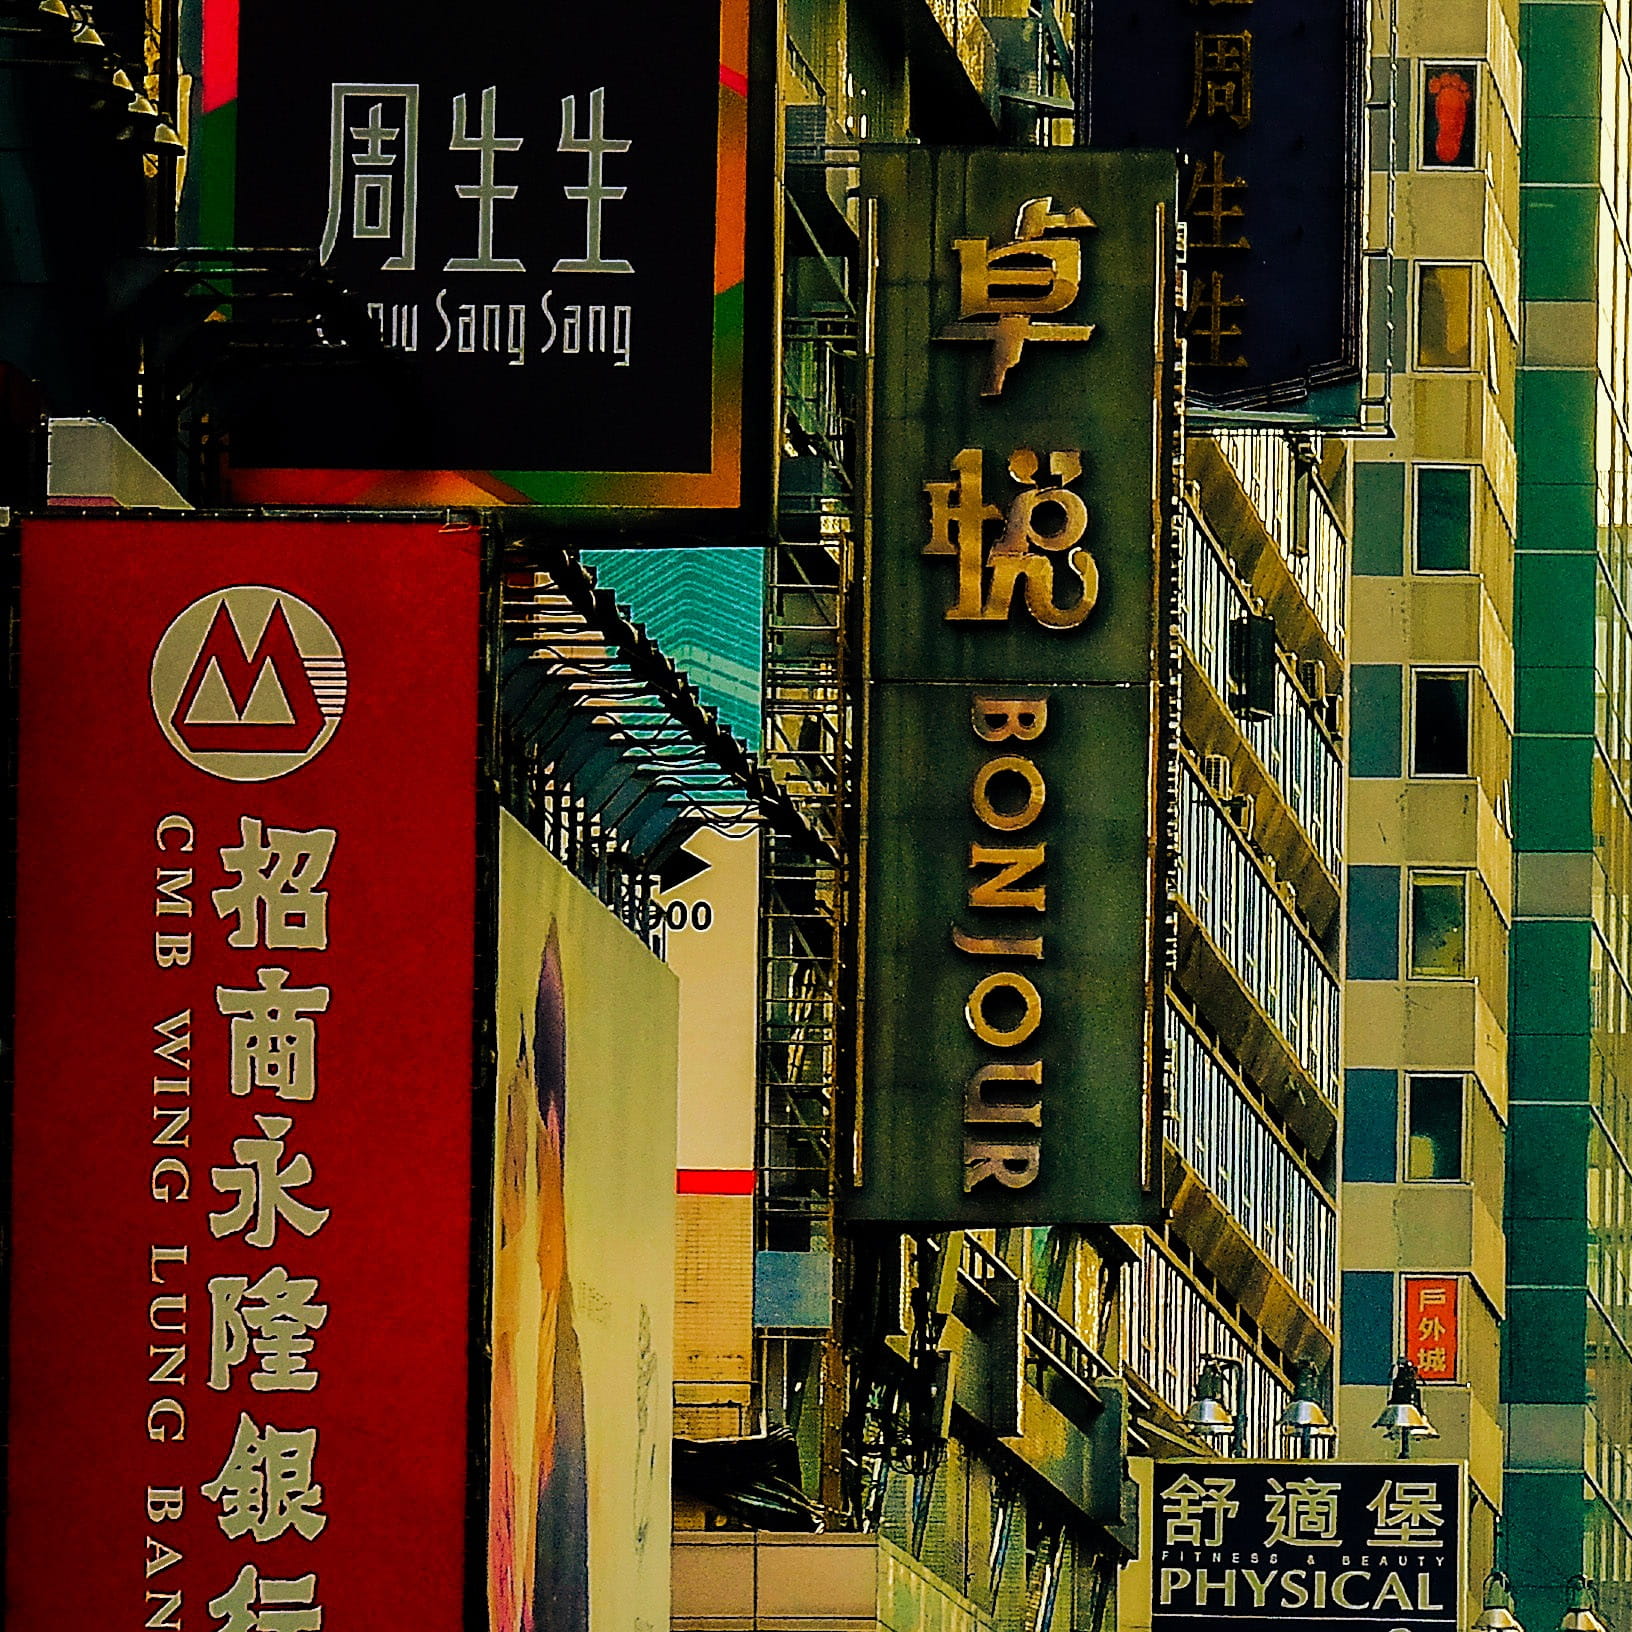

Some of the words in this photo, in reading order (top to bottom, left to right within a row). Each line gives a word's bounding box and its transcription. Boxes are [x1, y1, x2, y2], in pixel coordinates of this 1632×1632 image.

[319, 82, 636, 274] 周生生
[1184, 29, 1254, 369] 周生生
[435, 288, 526, 366] Sang
[541, 290, 632, 367] Sang
[153, 814, 195, 970] CMB
[952, 693, 1049, 1194] BONJOUR
[151, 1008, 192, 1204] WING
[146, 1243, 190, 1443] LUNG
[1159, 1472, 1446, 1548] 舒適堡
[1159, 1568, 1444, 1612] PHYSICAL
[1161, 1550, 1279, 1564] FITNESS
[1342, 1554, 1447, 1567] BEAUTY
